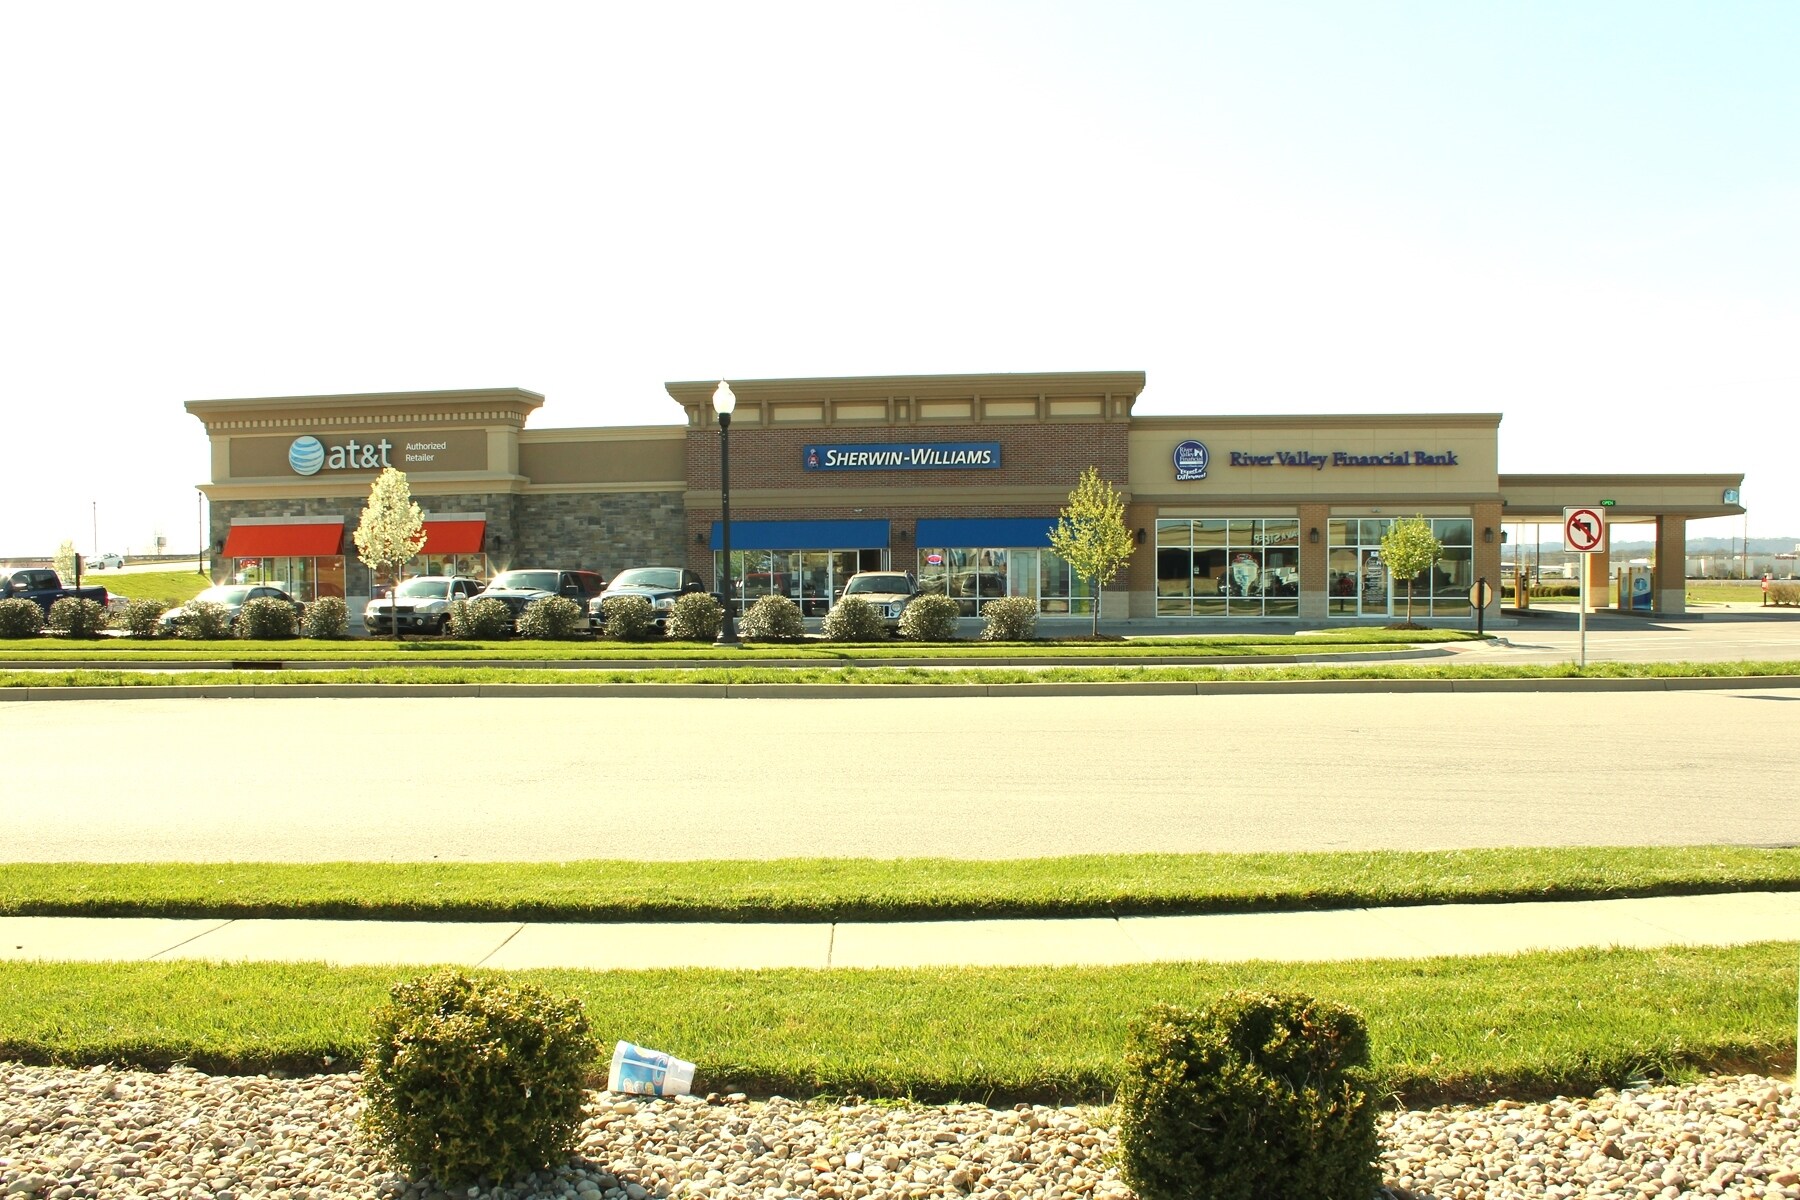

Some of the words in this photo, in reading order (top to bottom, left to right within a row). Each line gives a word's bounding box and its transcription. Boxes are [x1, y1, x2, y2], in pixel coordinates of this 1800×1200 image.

[328, 438, 392, 469] at&t
[406, 442, 447, 450] Authorized
[405, 454, 435, 462] Retailer
[825, 448, 991, 467] SHERWIN-WILLIAMS
[1229, 451, 1274, 467] River
[1276, 451, 1329, 471] Valley
[1332, 451, 1411, 467] Financial
[1414, 450, 1459, 466] Bank
